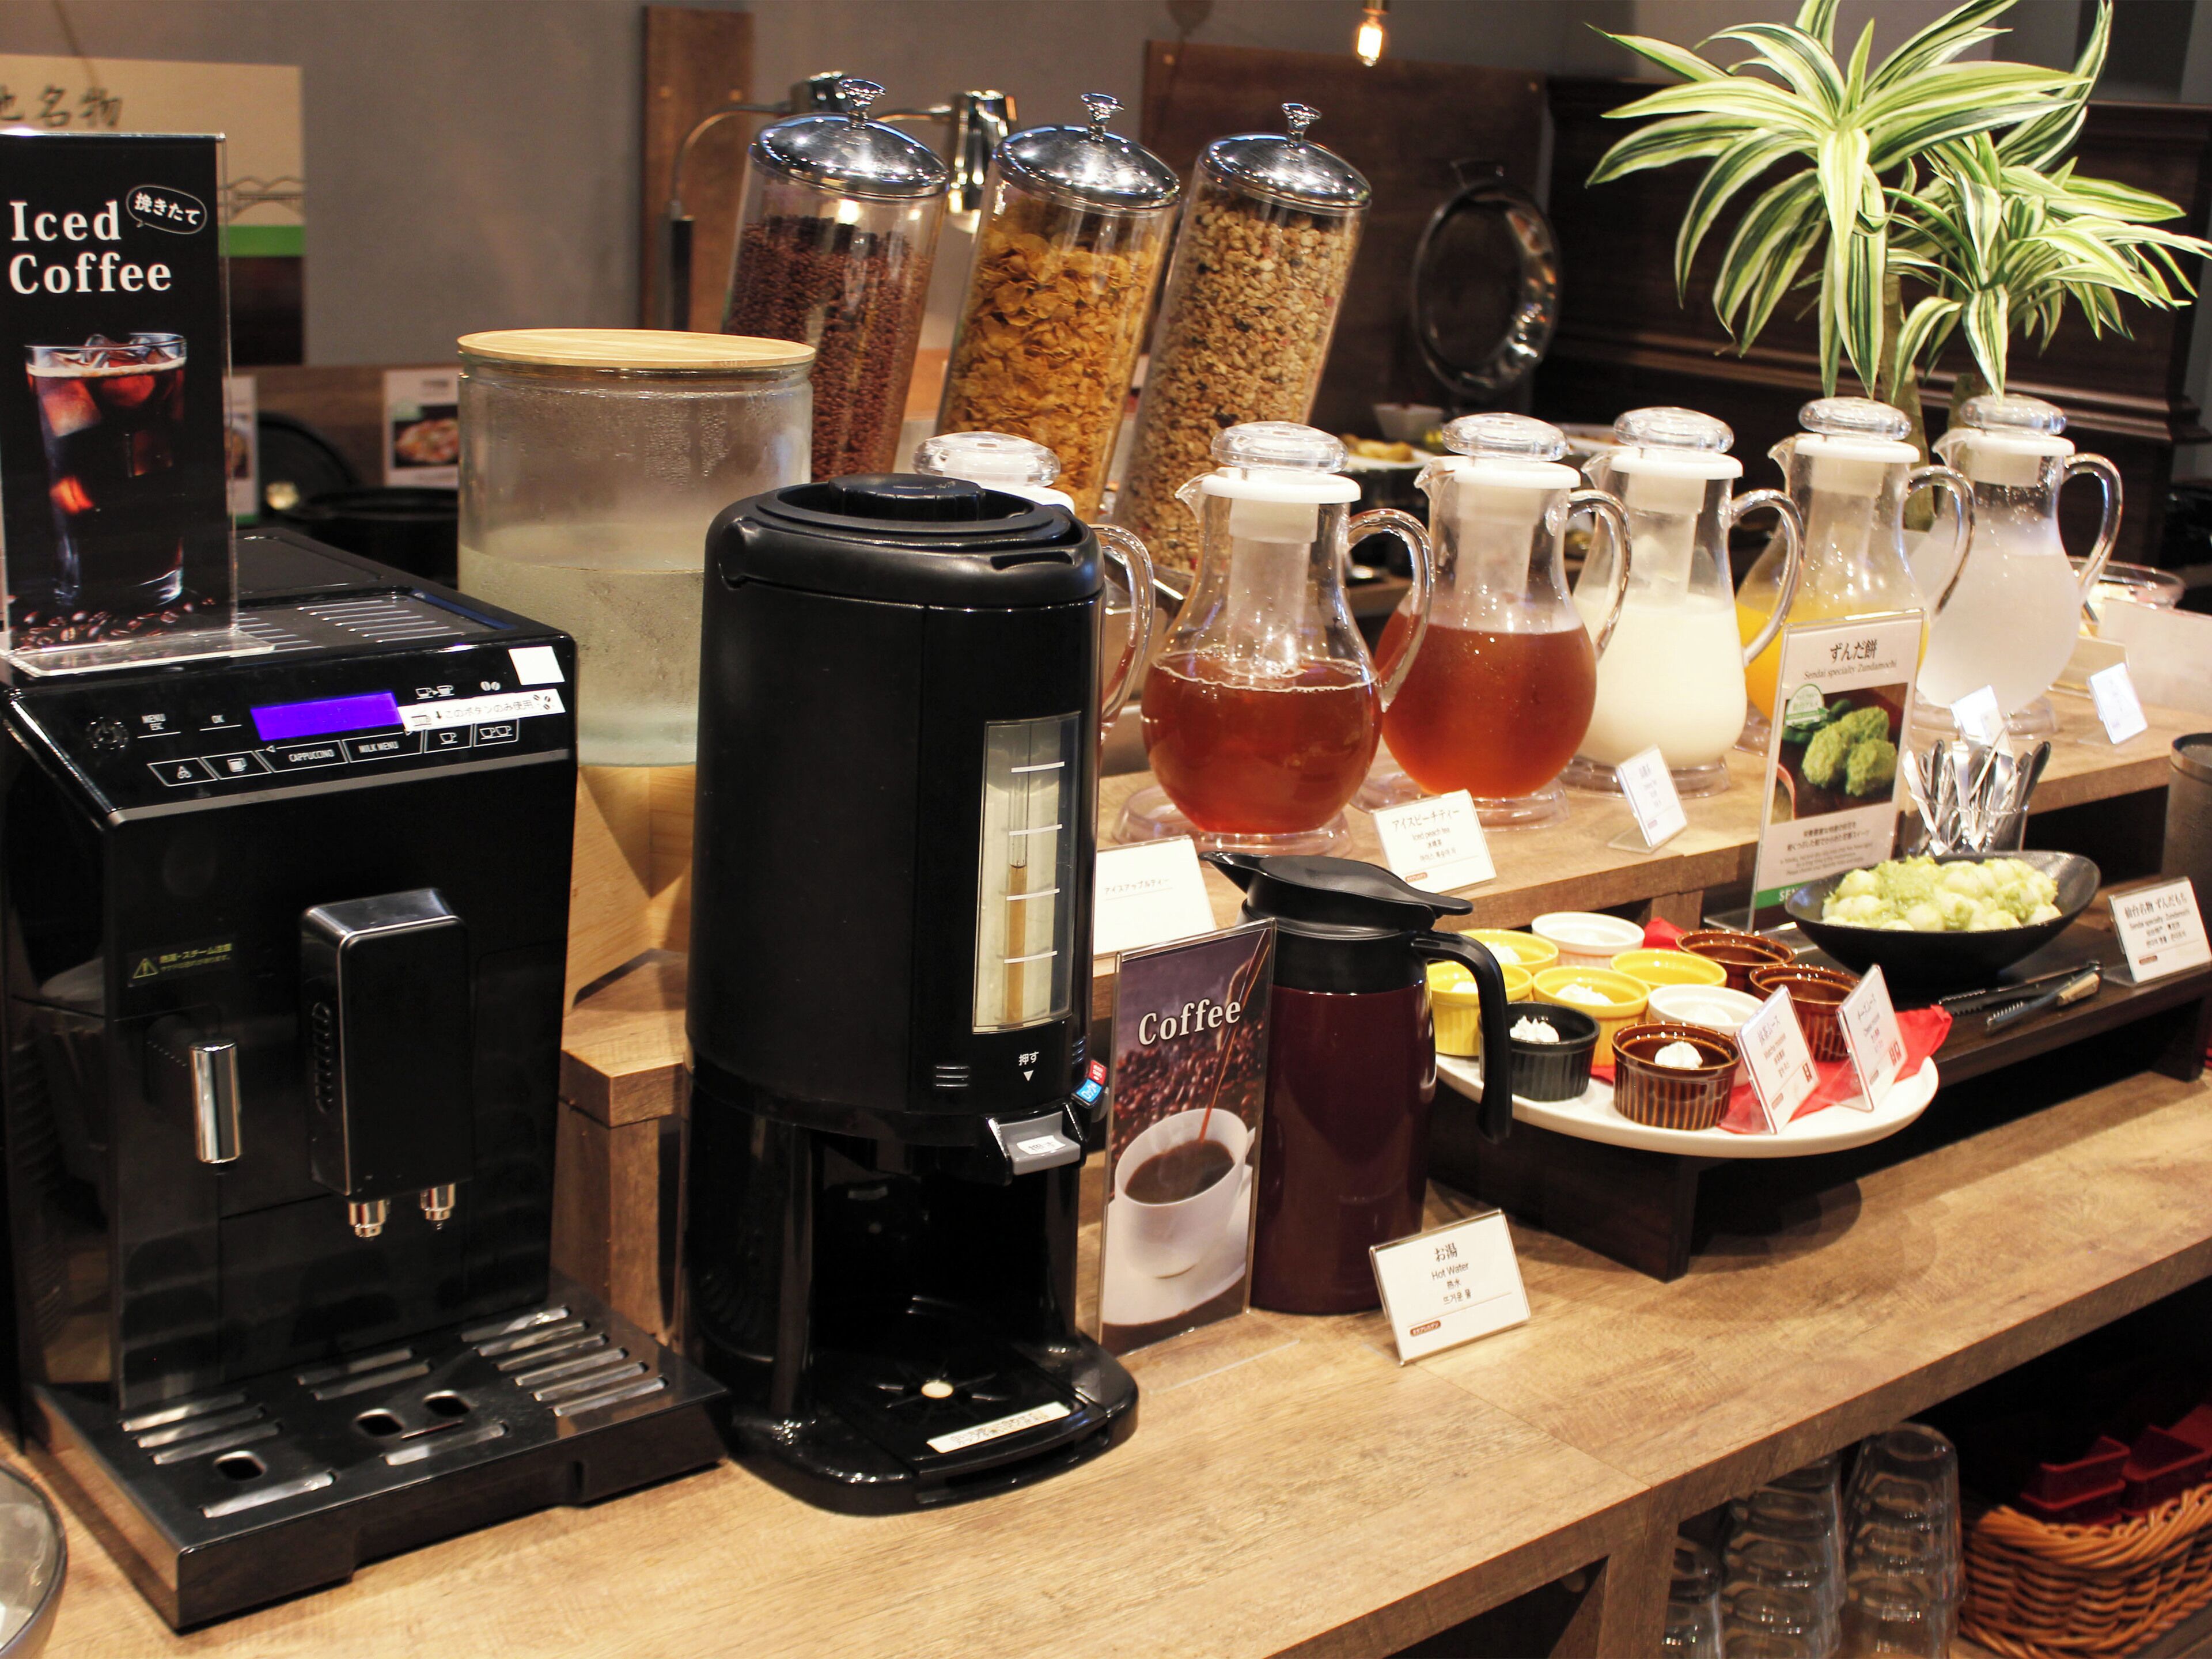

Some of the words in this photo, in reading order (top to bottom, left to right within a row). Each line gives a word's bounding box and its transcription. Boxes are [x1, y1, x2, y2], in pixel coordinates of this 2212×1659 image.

[135, 192, 200, 225] 挽きたて
[9, 199, 122, 242] Iced
[9, 251, 172, 295] Coffee
[1830, 638, 1878, 663] ずんだ餅
[1804, 669, 1826, 680] Sendai
[1828, 665, 1855, 678] specialty
[141, 713, 166, 724] MENU
[211, 714, 225, 724] OK
[445, 700, 533, 719] このボタンのみ使用
[289, 749, 336, 763] CAPPUCCINO
[358, 743, 378, 753] MILK
[378, 741, 399, 751] MENU
[1392, 809, 1460, 832] アイスピーチティー
[1138, 999, 1241, 1047] Coffee
[1018, 1051, 1039, 1066] 押す
[1434, 1243, 1458, 1262] お湯
[1431, 1269, 1446, 1280] Hot
[1446, 1263, 1469, 1275] Water
